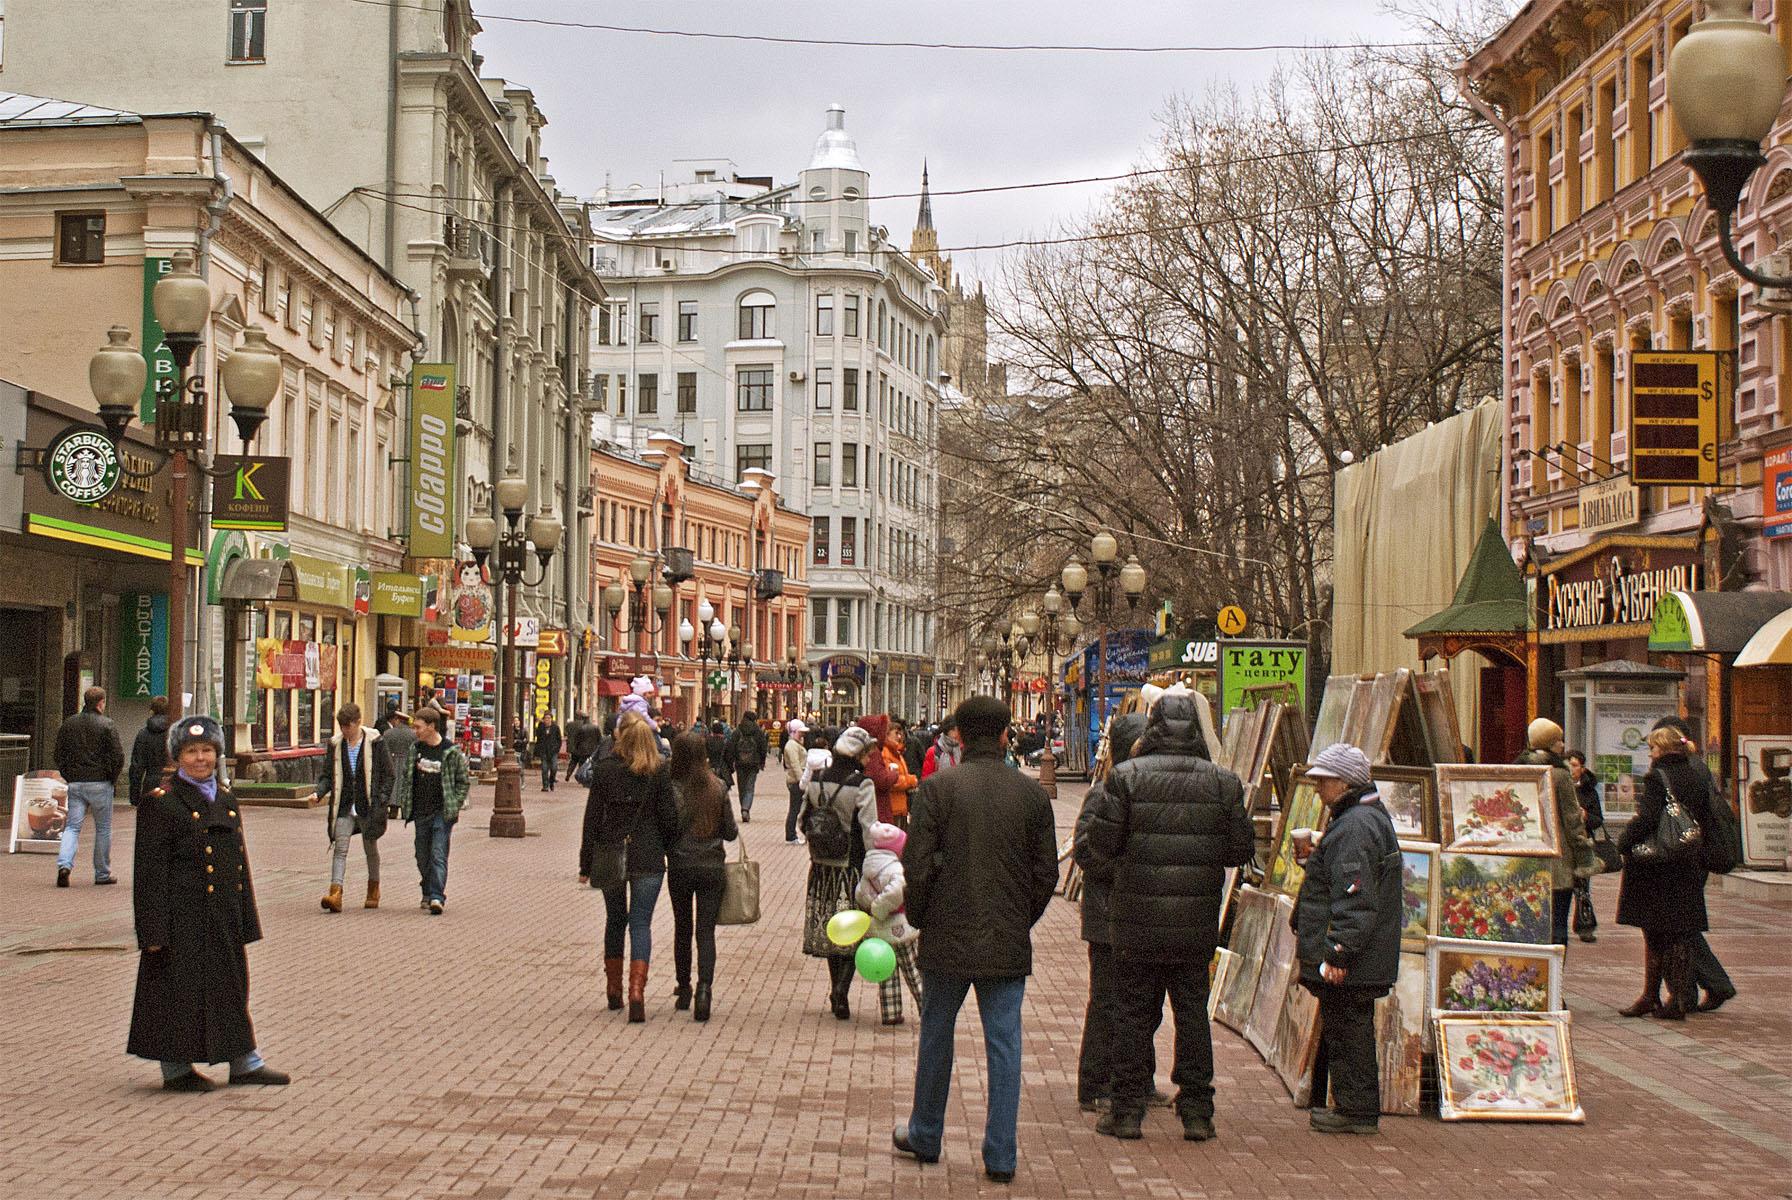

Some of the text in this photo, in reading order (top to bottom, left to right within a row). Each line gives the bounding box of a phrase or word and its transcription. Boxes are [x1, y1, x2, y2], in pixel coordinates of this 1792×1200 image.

[1701, 380, 1713, 402] $
[55, 435, 117, 465] STARBUCKS
[1702, 443, 1715, 462] €
[60, 480, 108, 499] COFFEE
[1582, 490, 1634, 529] АВИАКАССА
[1547, 555, 1697, 629] Русские Сувениры
[136, 595, 154, 696] ВЫСТАВКА
[1181, 641, 1218, 663] SUB
